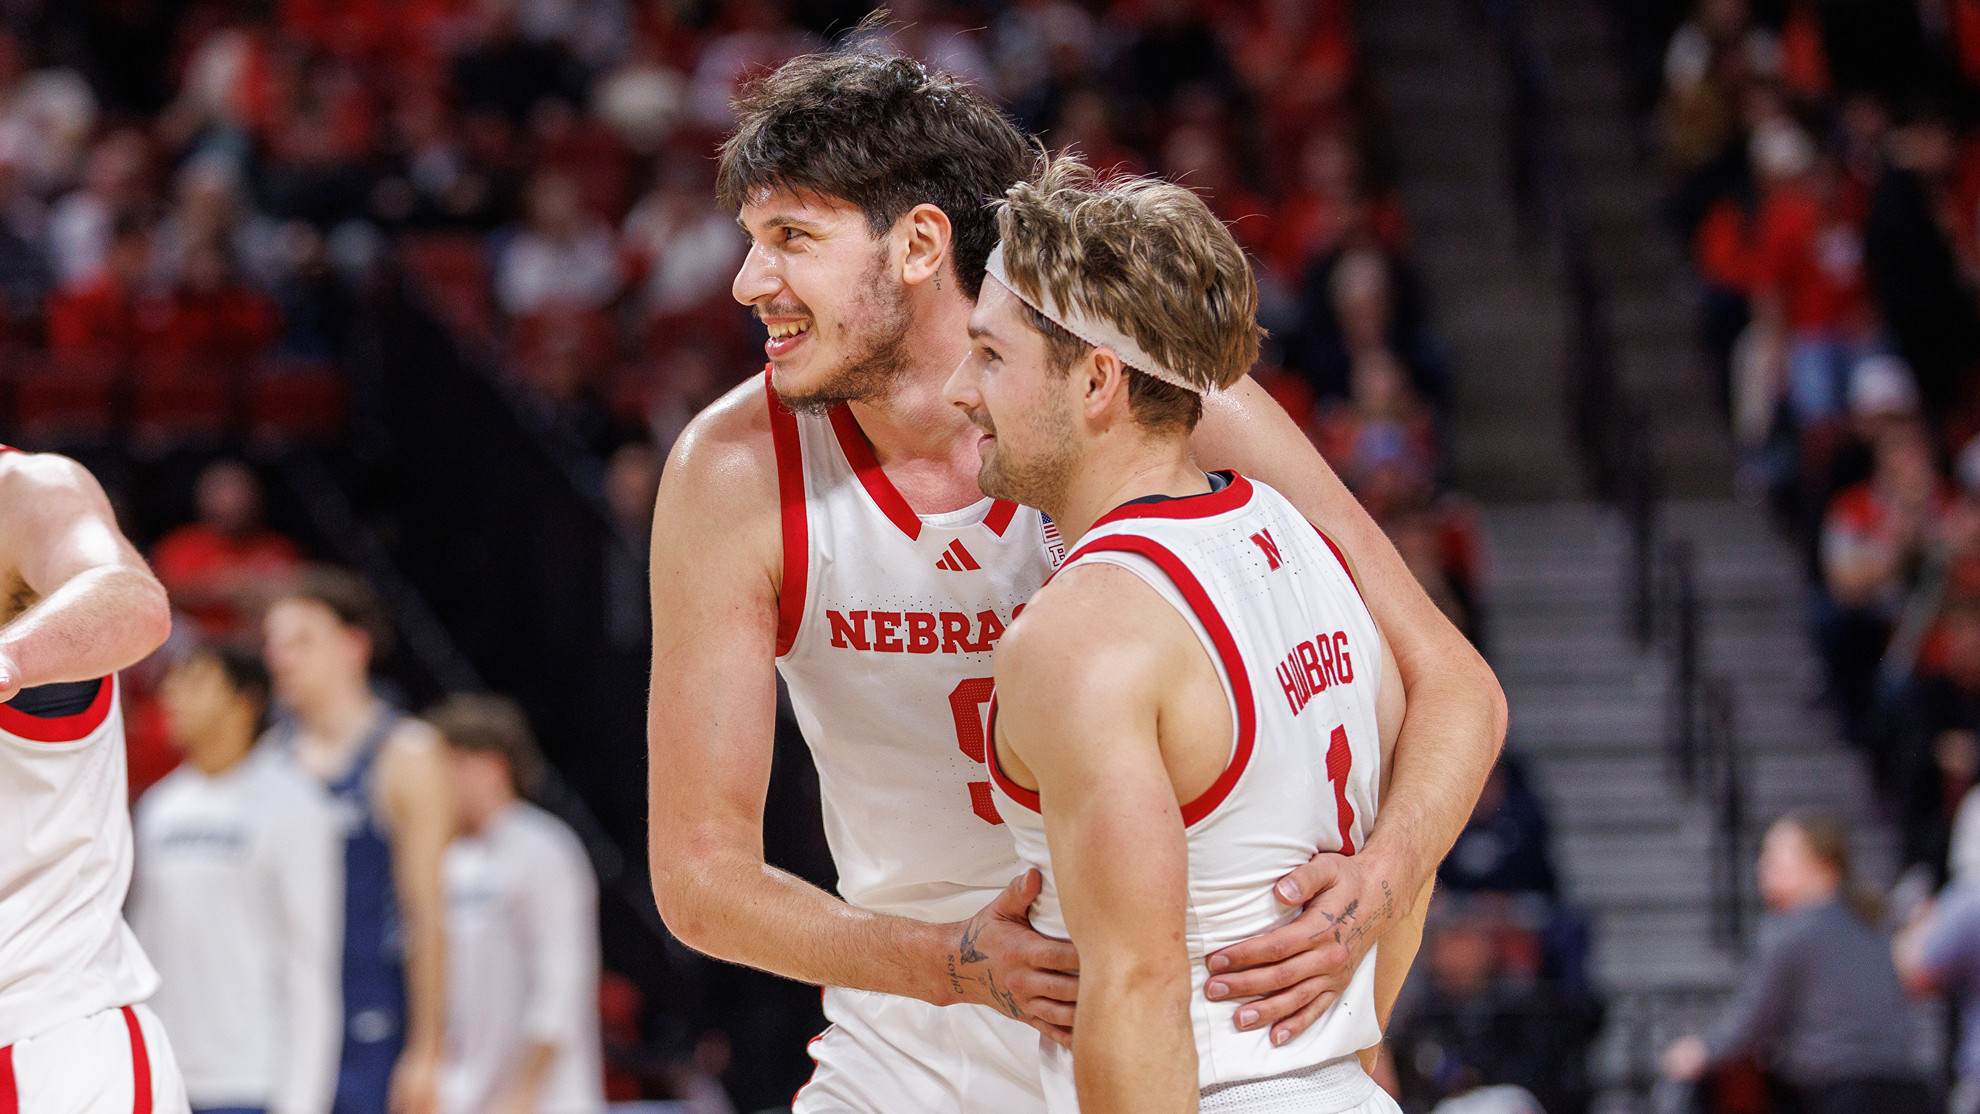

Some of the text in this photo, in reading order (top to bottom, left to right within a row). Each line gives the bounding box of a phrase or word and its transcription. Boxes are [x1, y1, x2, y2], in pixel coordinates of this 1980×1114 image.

[1249, 528, 1284, 572] N
[826, 602, 1028, 654] NEBRA
[1326, 724, 1356, 856] 1
